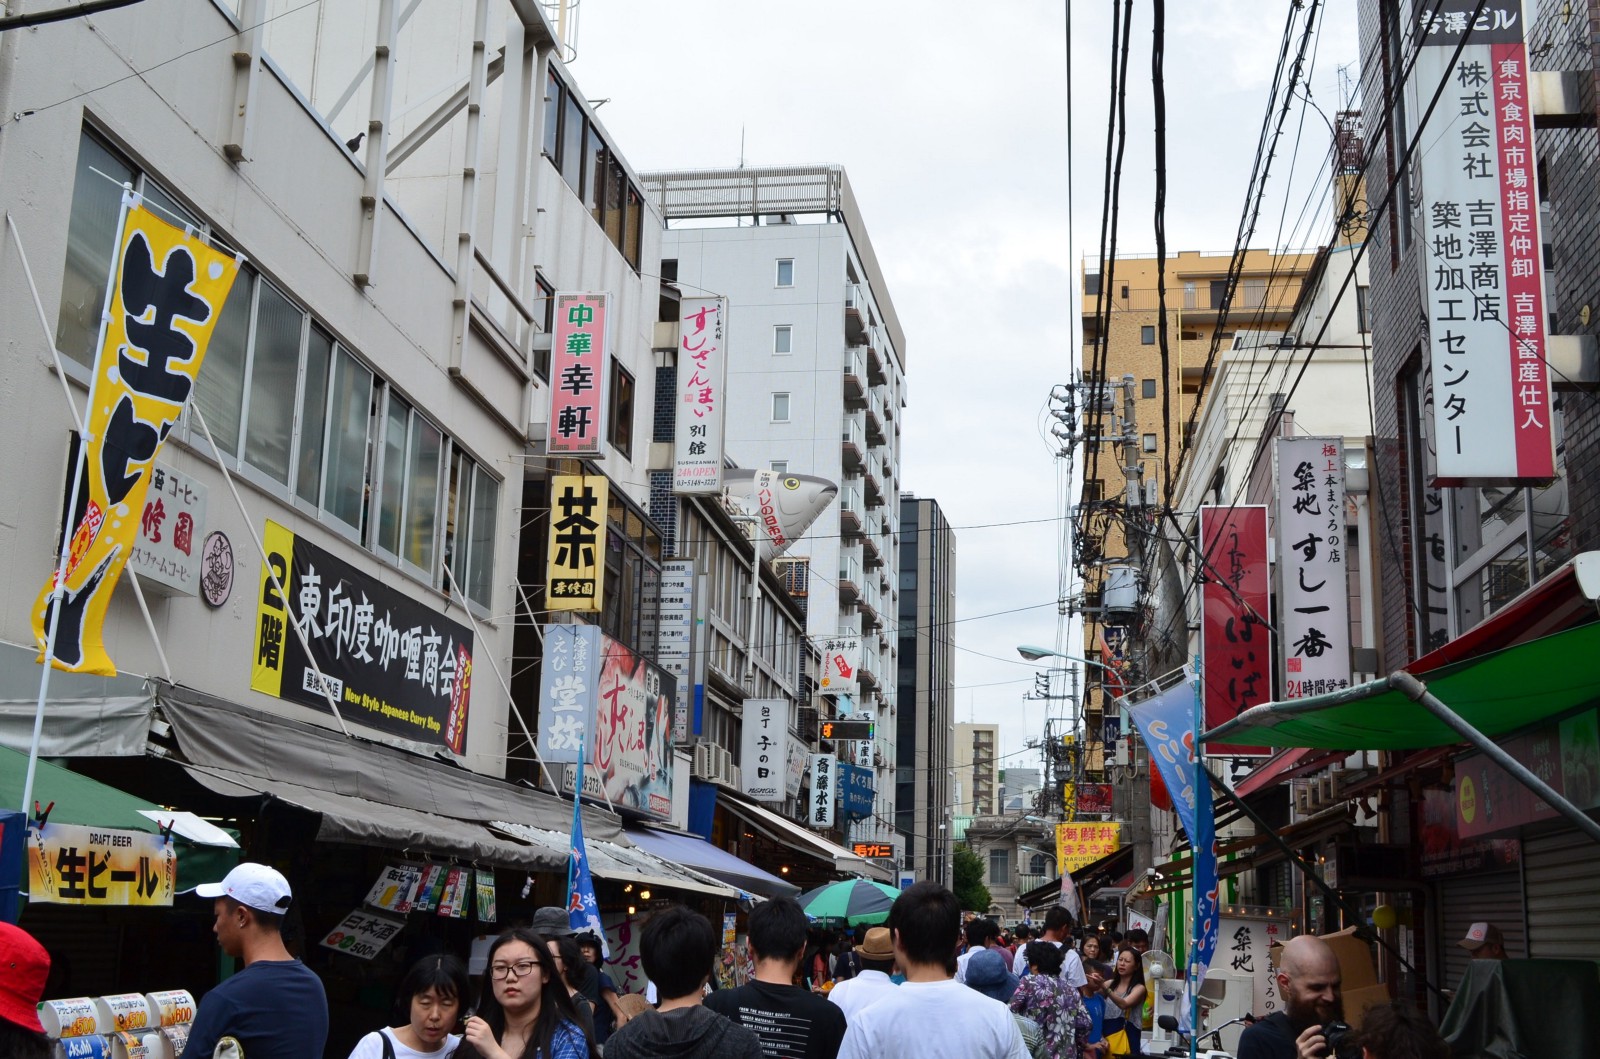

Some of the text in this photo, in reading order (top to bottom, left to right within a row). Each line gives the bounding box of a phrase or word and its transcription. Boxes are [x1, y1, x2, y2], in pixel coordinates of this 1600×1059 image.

[1457, 60, 1501, 322] 株式会社 吉澤商店
[1498, 59, 1543, 429] 東京食肉市場指定仲卸 吉澤畜産仕入
[1431, 201, 1469, 455] 築地加工センター
[682, 306, 717, 418] すしざんまい
[44, 229, 212, 667] 生ビル
[688, 424, 707, 456] 別館
[149, 467, 165, 492] 苔
[677, 467, 717, 477] 24h OPEN
[1321, 443, 1341, 564] 極上本まぐろの店
[553, 486, 600, 570] 茶
[1291, 461, 1333, 658] 築地 すし一番
[258, 551, 287, 671] 2階
[551, 635, 568, 672] えび
[572, 636, 589, 672] 冷凍品
[345, 687, 441, 734] New Style Japanese Curry Shop
[757, 706, 772, 778] 包丁 子の日
[89, 833, 132, 848] DRAFT BEER
[1062, 827, 1114, 842] 海鮮丼
[1063, 844, 1115, 856] まるきた
[55, 847, 159, 899] 生ビール
[341, 914, 400, 941] 日本酒
[1231, 926, 1255, 973] 築地
[72, 1016, 96, 1035] ¥500
[125, 1011, 148, 1029] ¥500
[171, 1007, 192, 1024] ¥600
[68, 1038, 92, 1058] Asahi
[129, 1045, 150, 1055] SAPPORO
